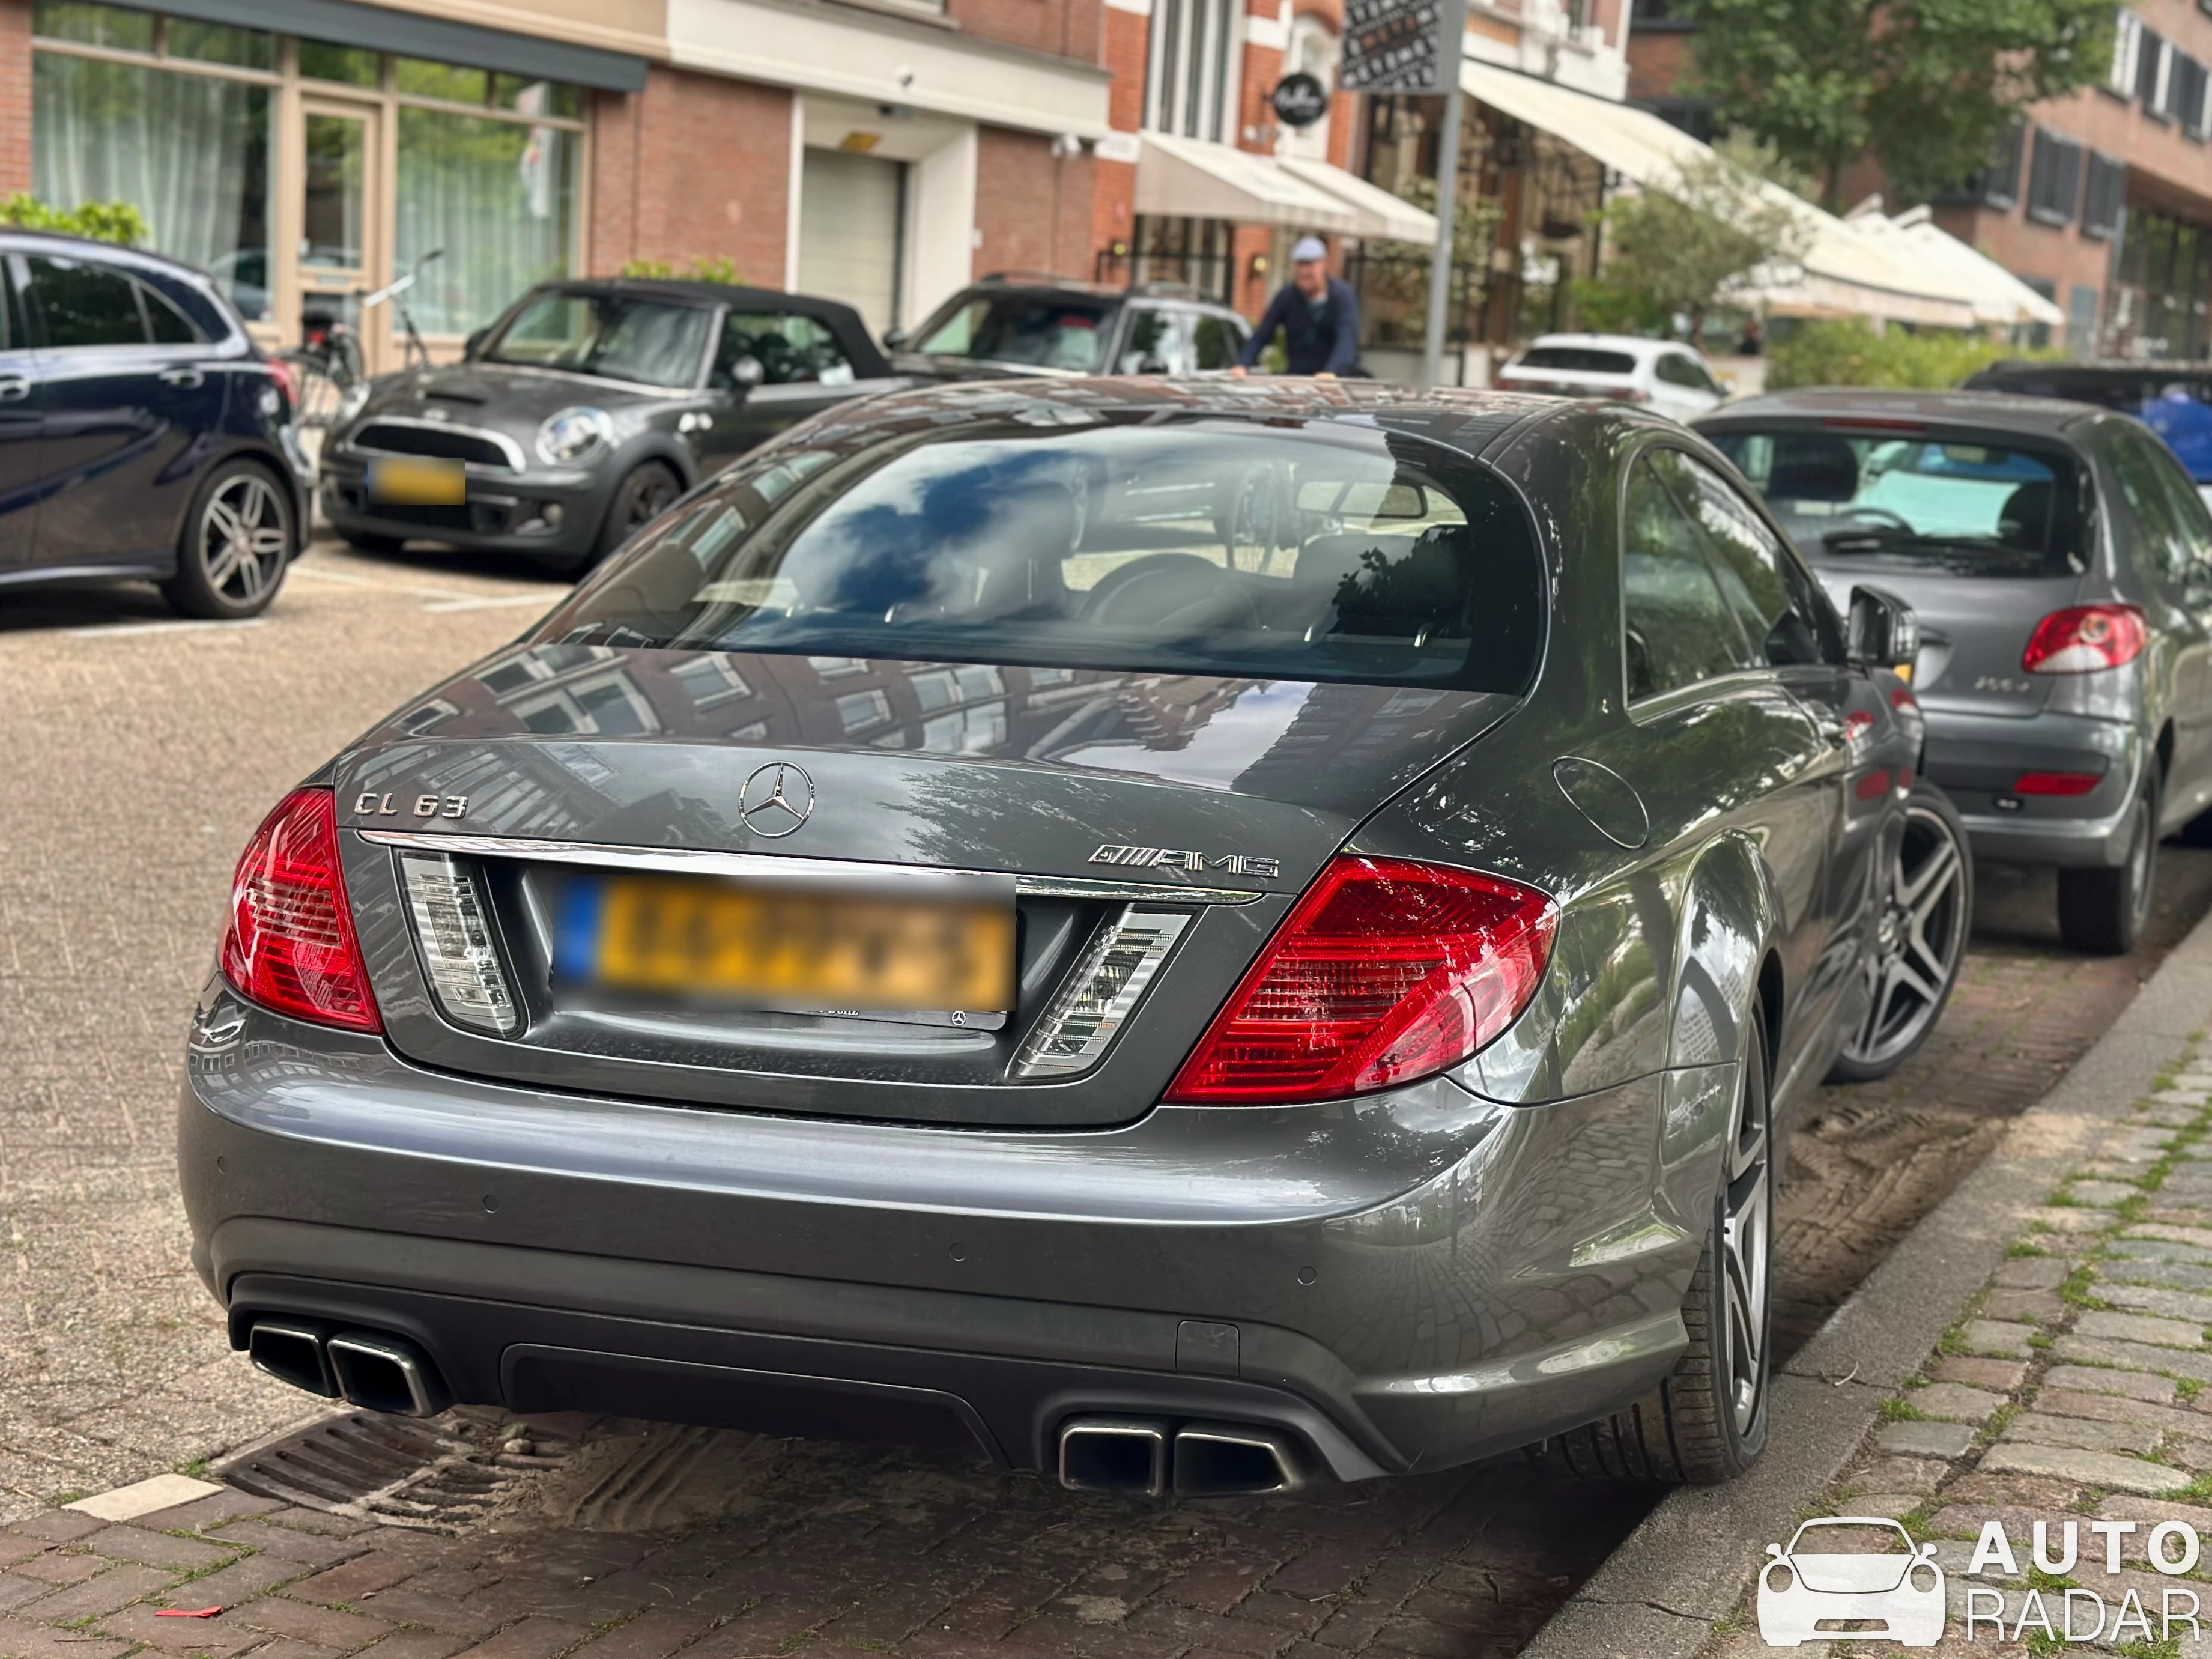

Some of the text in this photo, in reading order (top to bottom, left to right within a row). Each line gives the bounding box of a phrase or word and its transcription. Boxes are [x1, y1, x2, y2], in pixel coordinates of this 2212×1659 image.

[354, 793, 469, 818] CL 63
[1148, 848, 1279, 878] AMG
